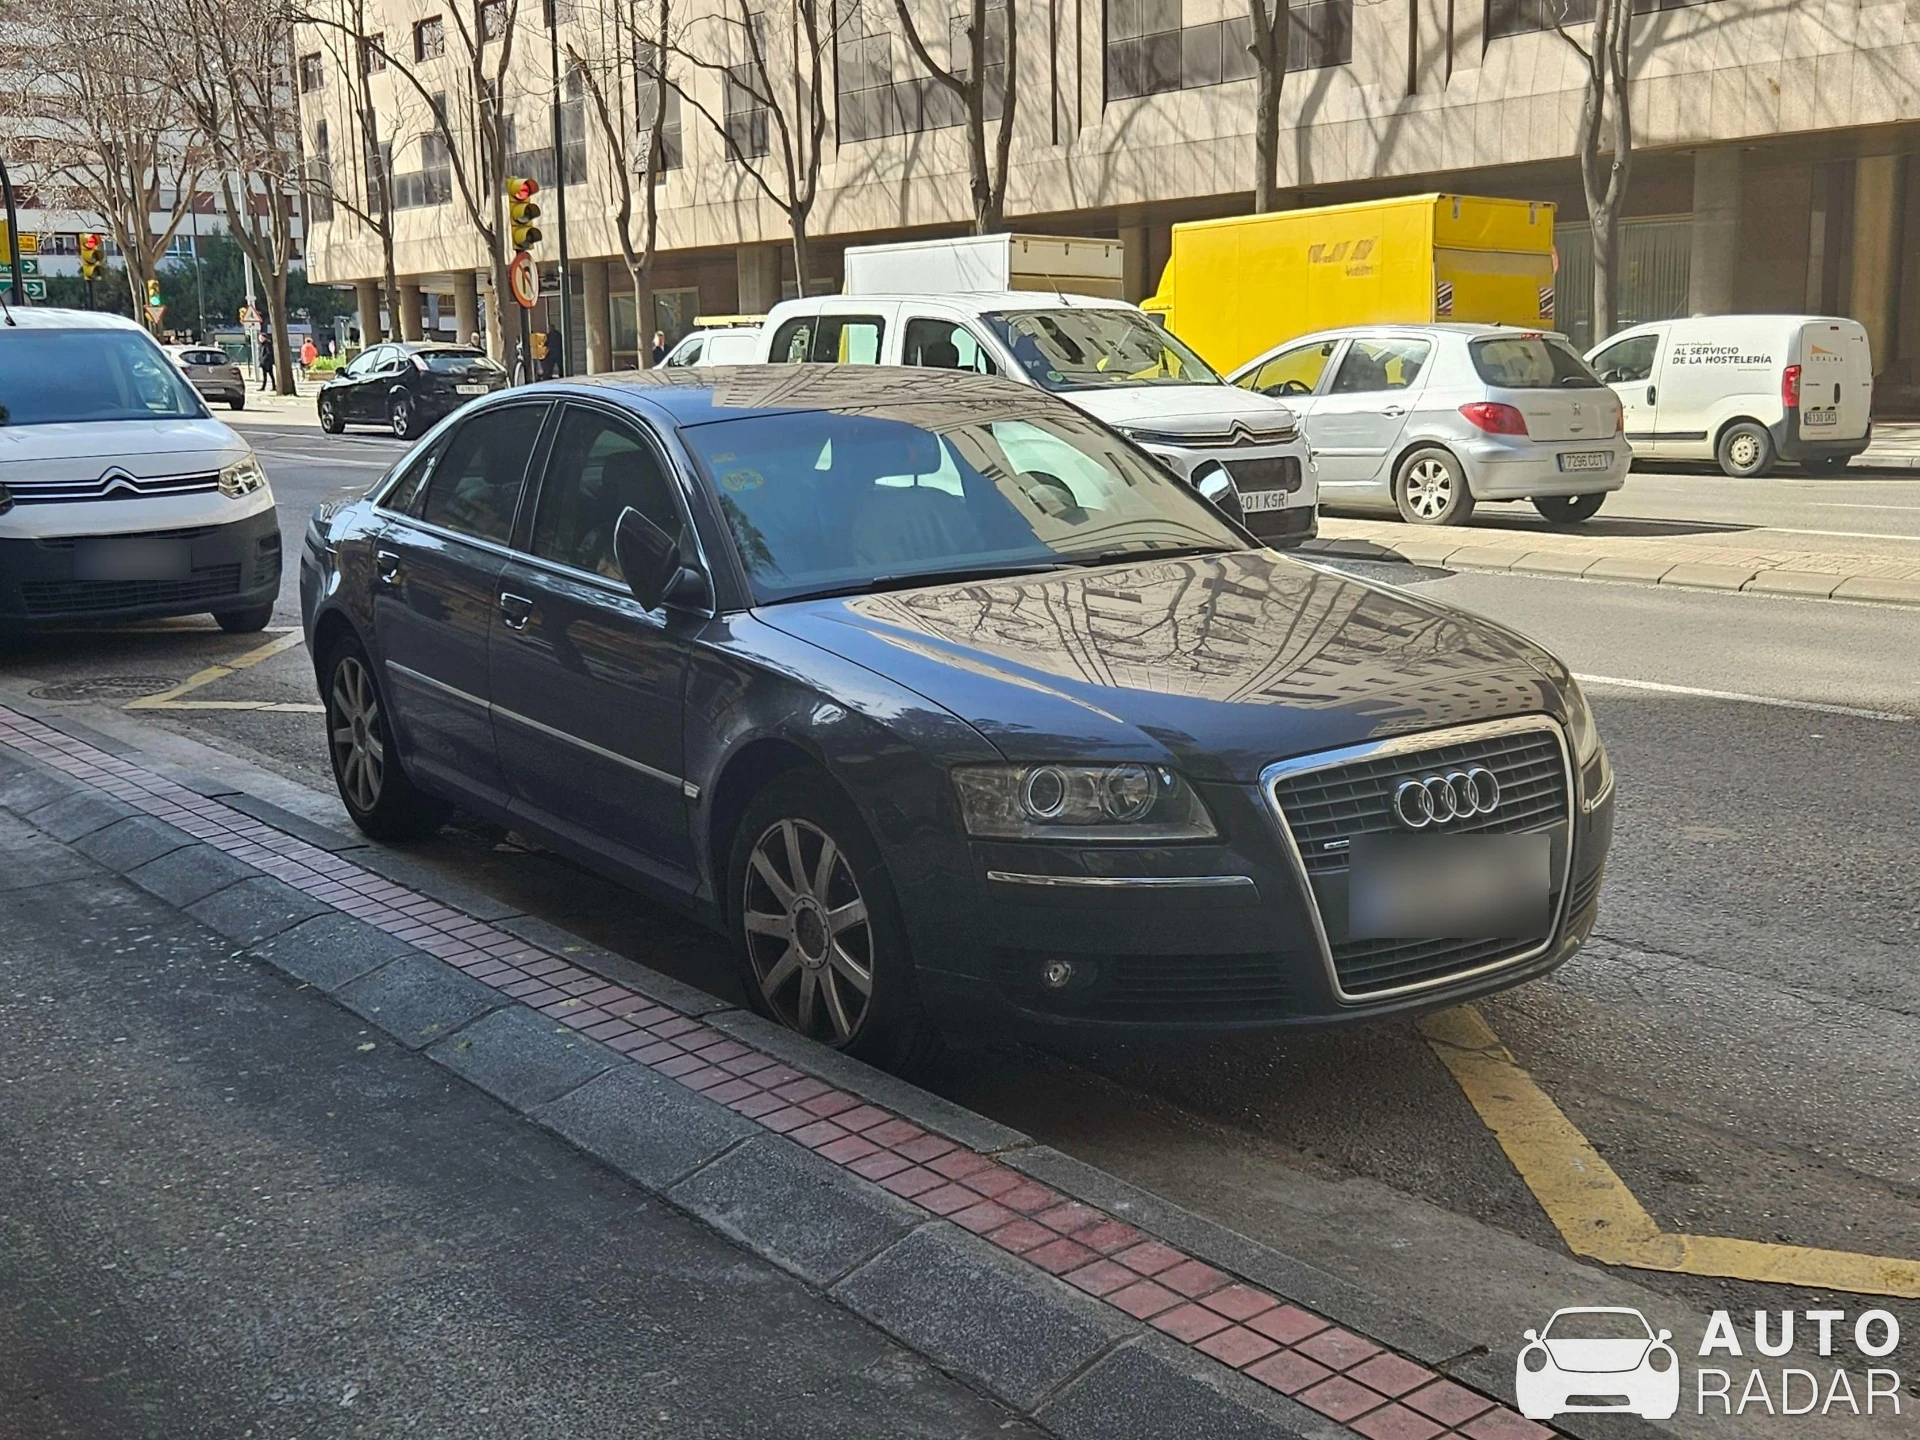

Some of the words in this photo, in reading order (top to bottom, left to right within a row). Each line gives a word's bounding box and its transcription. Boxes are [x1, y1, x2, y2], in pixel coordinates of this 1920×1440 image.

[1690, 347, 1739, 355] SERVICIO
[1689, 356, 1702, 364] LA
[1705, 353, 1772, 364] HOSTELERÍA
[1566, 455, 1587, 467] 7296
[1588, 454, 1603, 466] CCT
[1263, 493, 1285, 508] KSR
